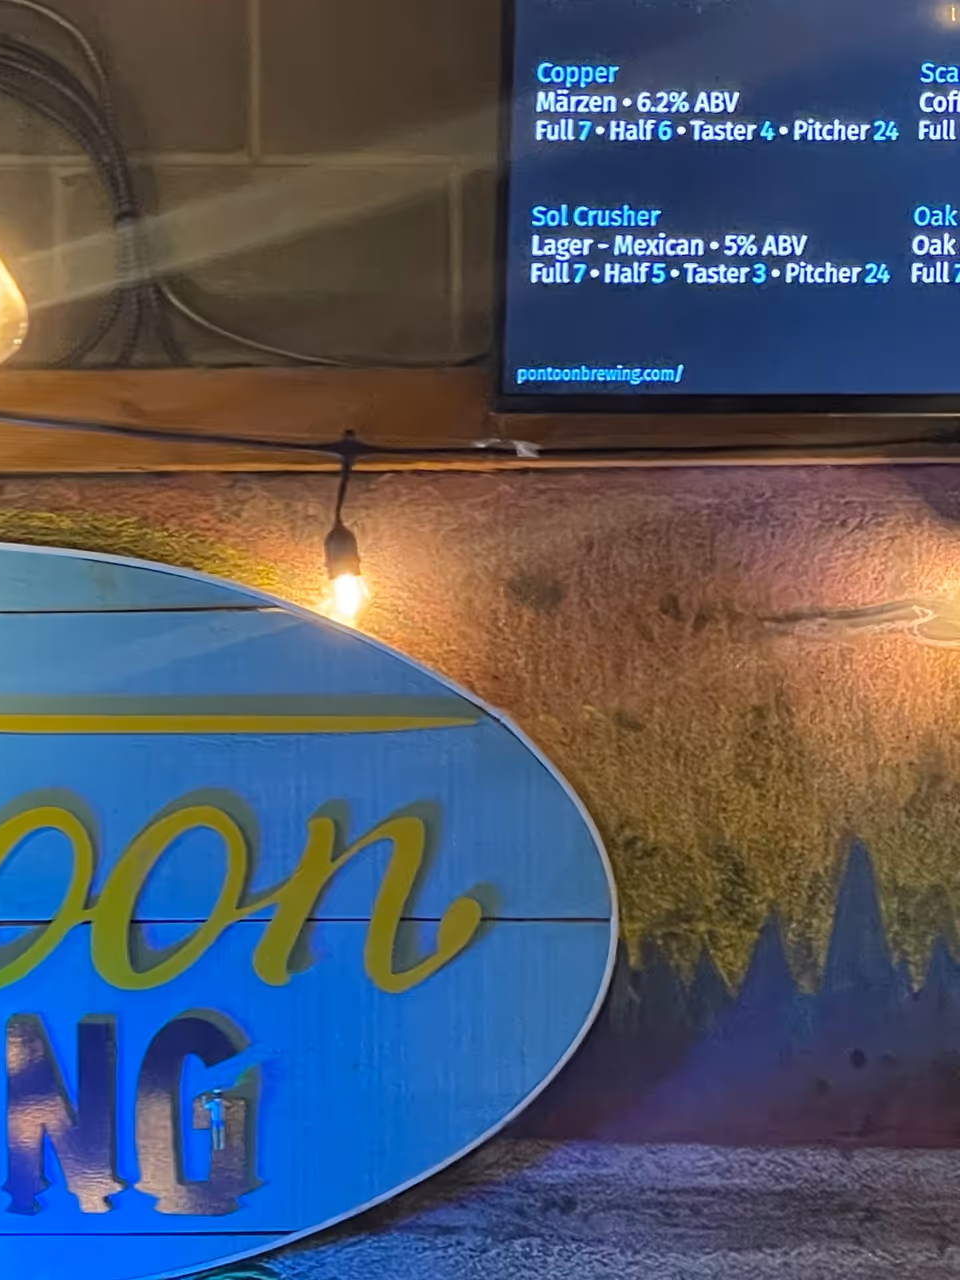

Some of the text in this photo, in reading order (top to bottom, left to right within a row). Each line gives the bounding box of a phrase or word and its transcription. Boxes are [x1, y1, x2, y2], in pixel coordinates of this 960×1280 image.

[537, 62, 619, 88] Copper
[535, 89, 739, 112] Märzen 6.2% ABV
[535, 119, 899, 141] Full 7 Half 6 Taster 4 Pitcher 24
[918, 119, 956, 140] Full
[531, 204, 661, 227] Sol Crusher
[914, 204, 958, 226] Oak
[531, 235, 594, 261] Lager
[614, 233, 704, 257] Mexican
[724, 235, 757, 256] 5%
[762, 235, 807, 256] ABV
[912, 232, 956, 255] Oak
[530, 262, 890, 285] Full 7 Half 5 Taster 3 Pitcher 24
[911, 261, 950, 283] Full
[516, 364, 684, 384] pontoonbrewing.com/
